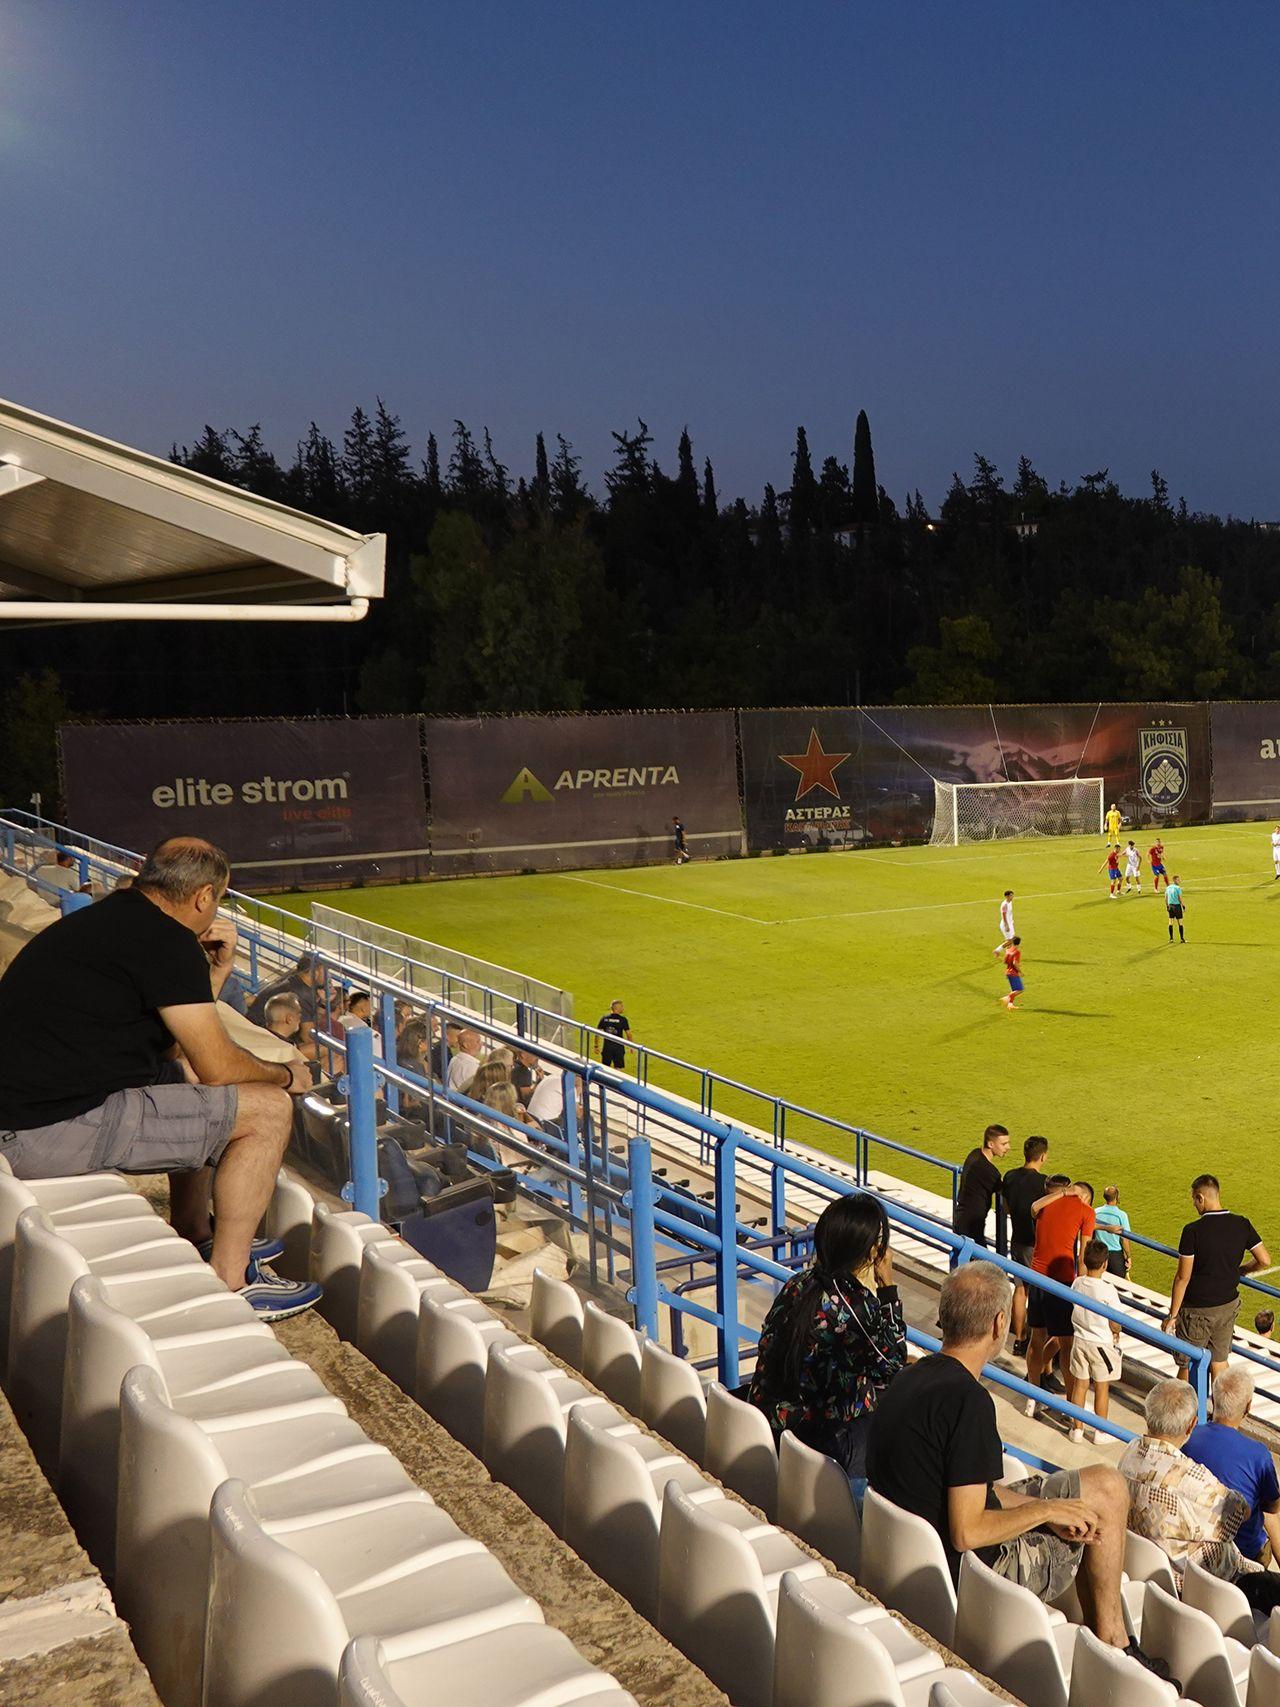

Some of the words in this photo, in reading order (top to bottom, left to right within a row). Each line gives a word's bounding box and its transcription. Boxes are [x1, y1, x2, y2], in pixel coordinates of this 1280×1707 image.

[1143, 732, 1184, 750] ΚΗΦΙΣΙΑ
[553, 766, 680, 791] APRENTA
[152, 777, 234, 808] elite
[241, 776, 348, 804] strom
[784, 805, 850, 821] ΑΣΤΕΡΑΣ
